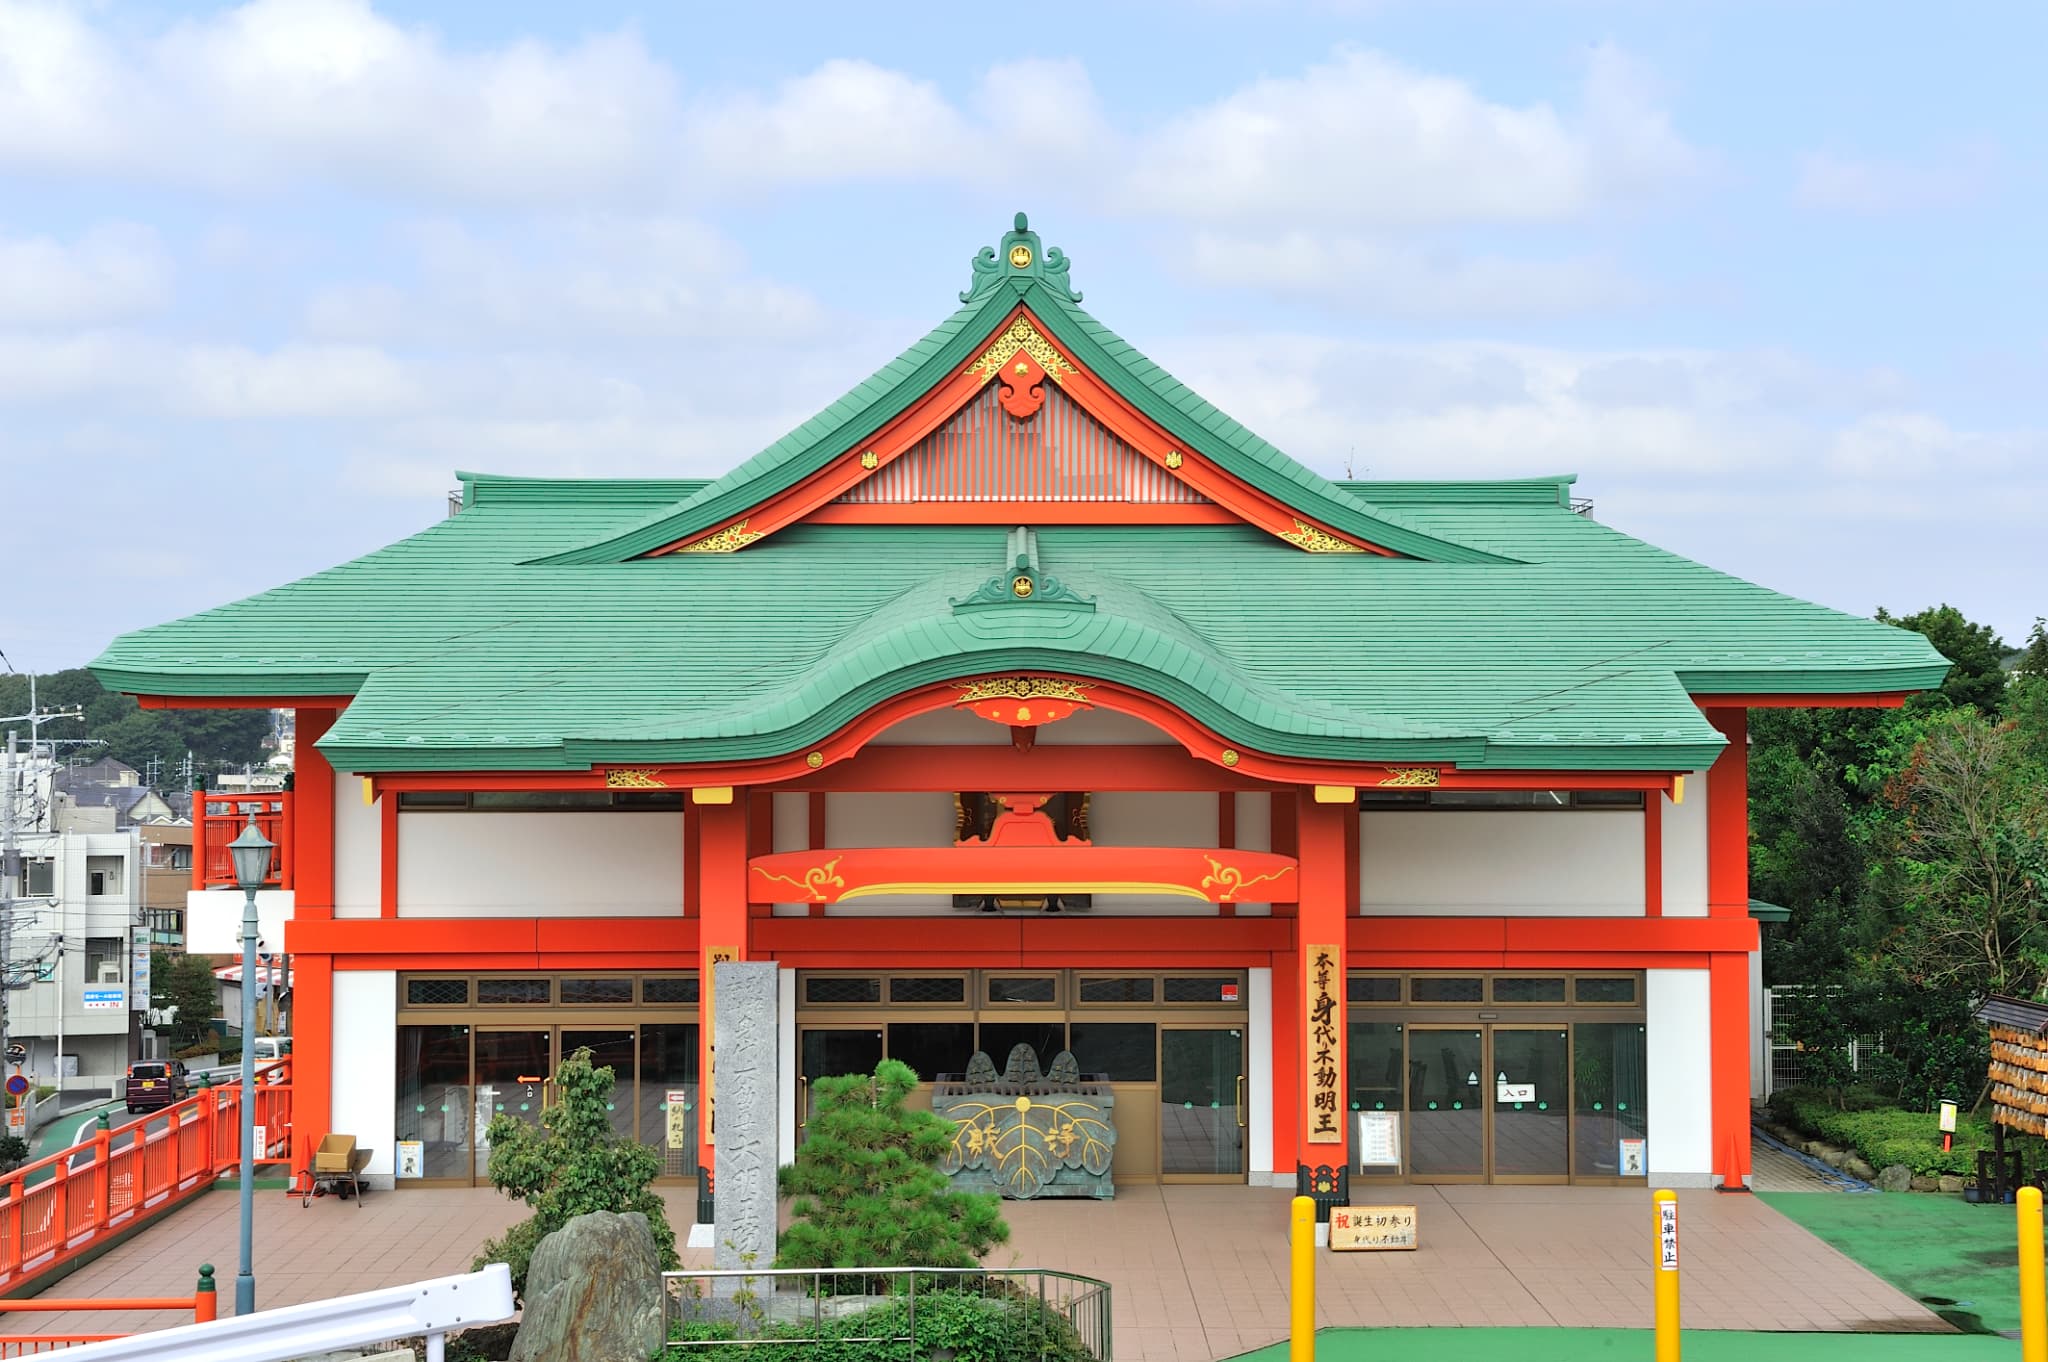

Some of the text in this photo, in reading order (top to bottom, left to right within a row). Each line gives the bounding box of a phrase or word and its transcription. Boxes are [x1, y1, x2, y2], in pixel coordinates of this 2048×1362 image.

[1311, 952, 1337, 1134] 本尊身代り不動明王
[1503, 1088, 1528, 1097] 入口
[1662, 1209, 1677, 1263] 駐車禁止
